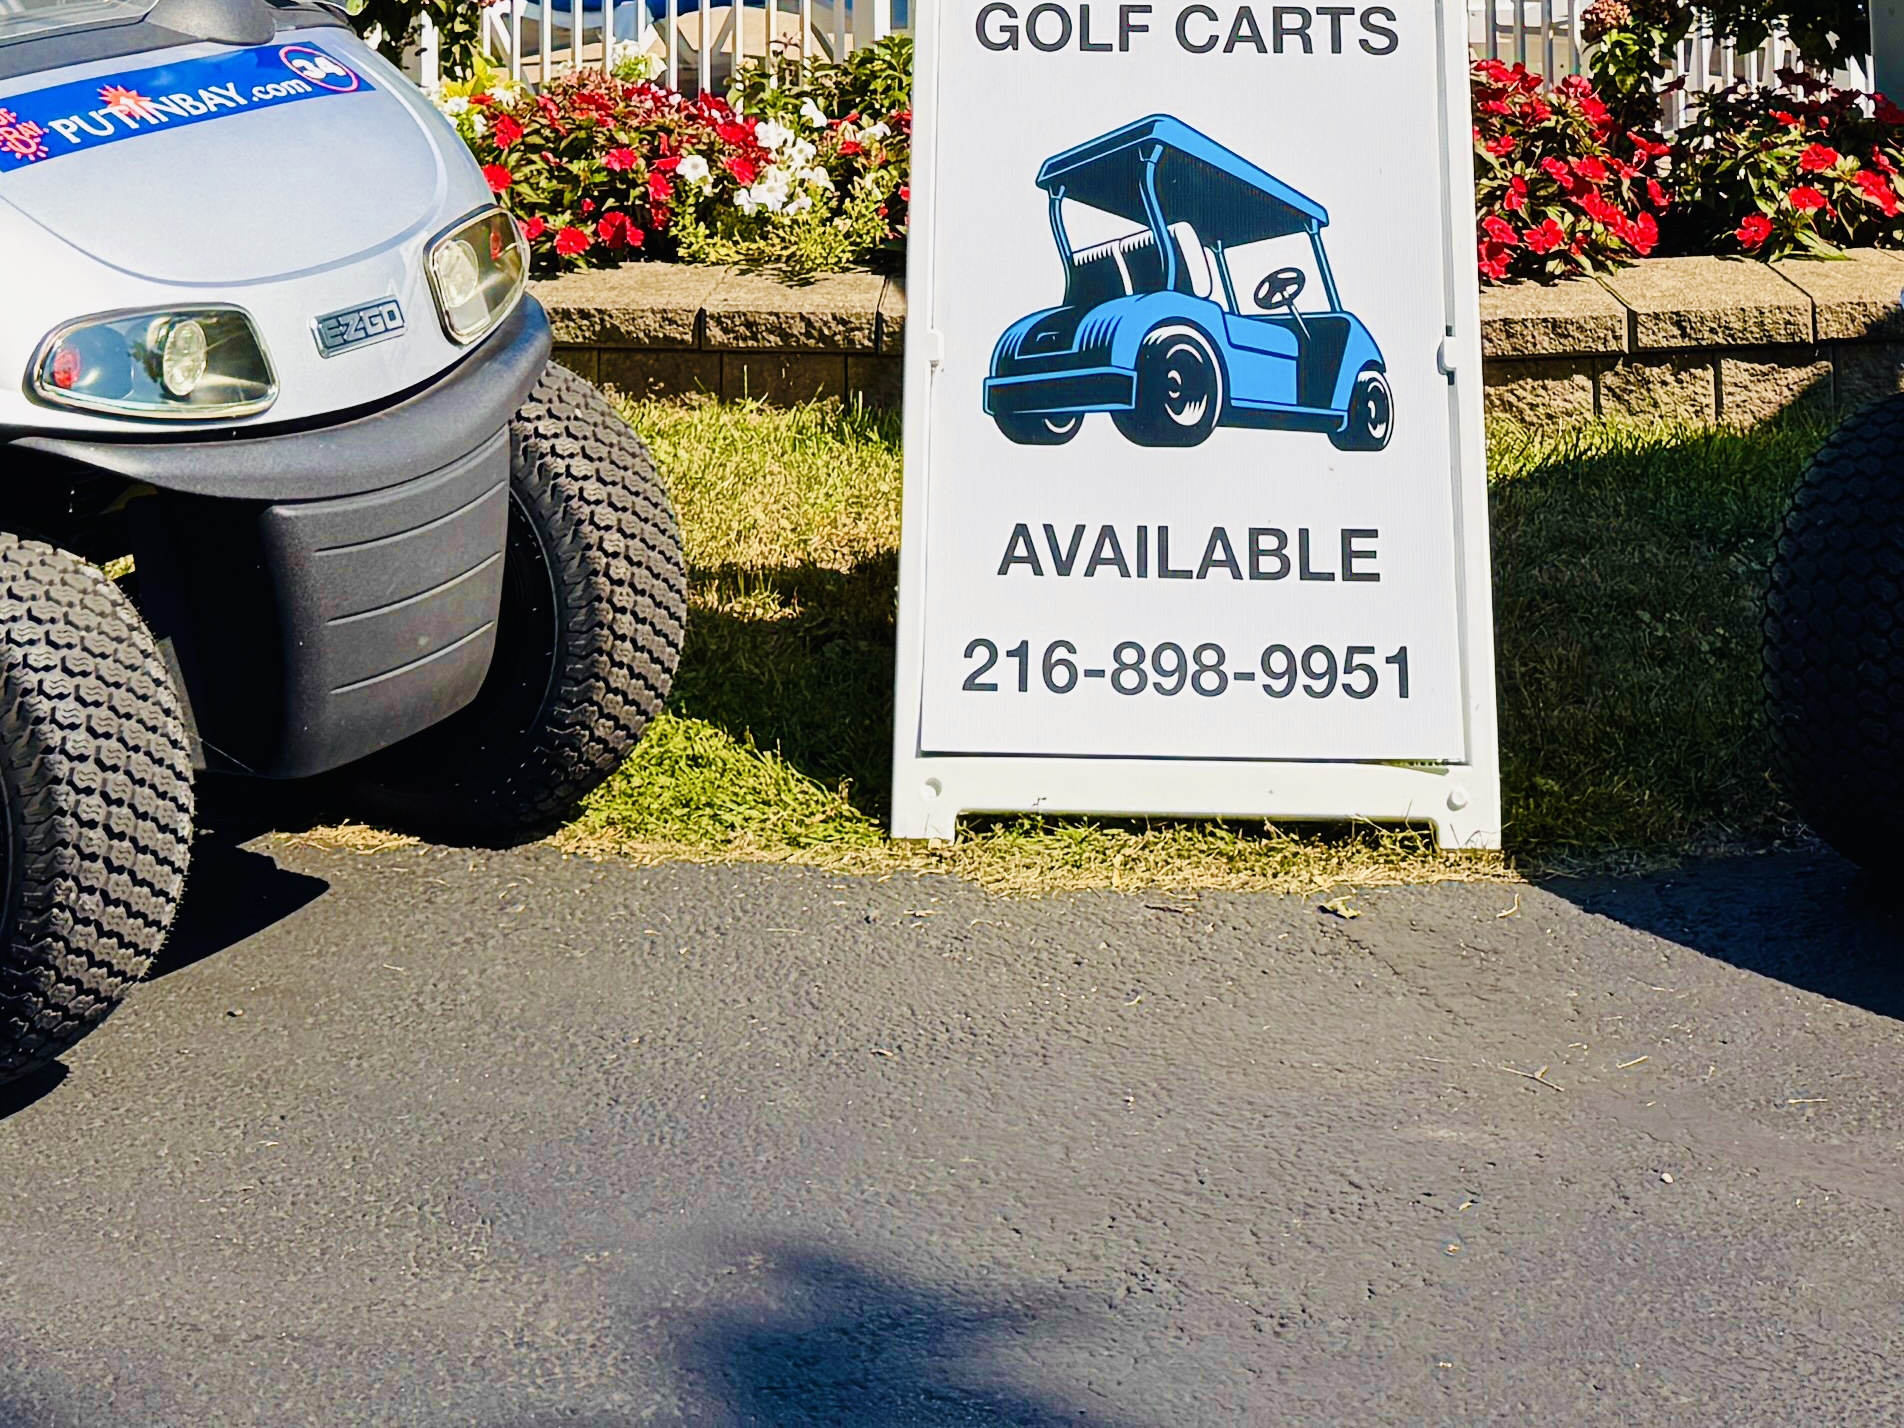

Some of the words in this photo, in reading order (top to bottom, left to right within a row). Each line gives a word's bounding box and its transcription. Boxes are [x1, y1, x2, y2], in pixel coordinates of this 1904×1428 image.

[974, 1, 1153, 54] GOLF
[1175, 3, 1399, 56] CARTS
[292, 54, 348, 80] 34
[320, 301, 404, 346] EZGO
[996, 523, 1382, 582] AVAILABLE
[961, 638, 1411, 700] 216-898-9951
